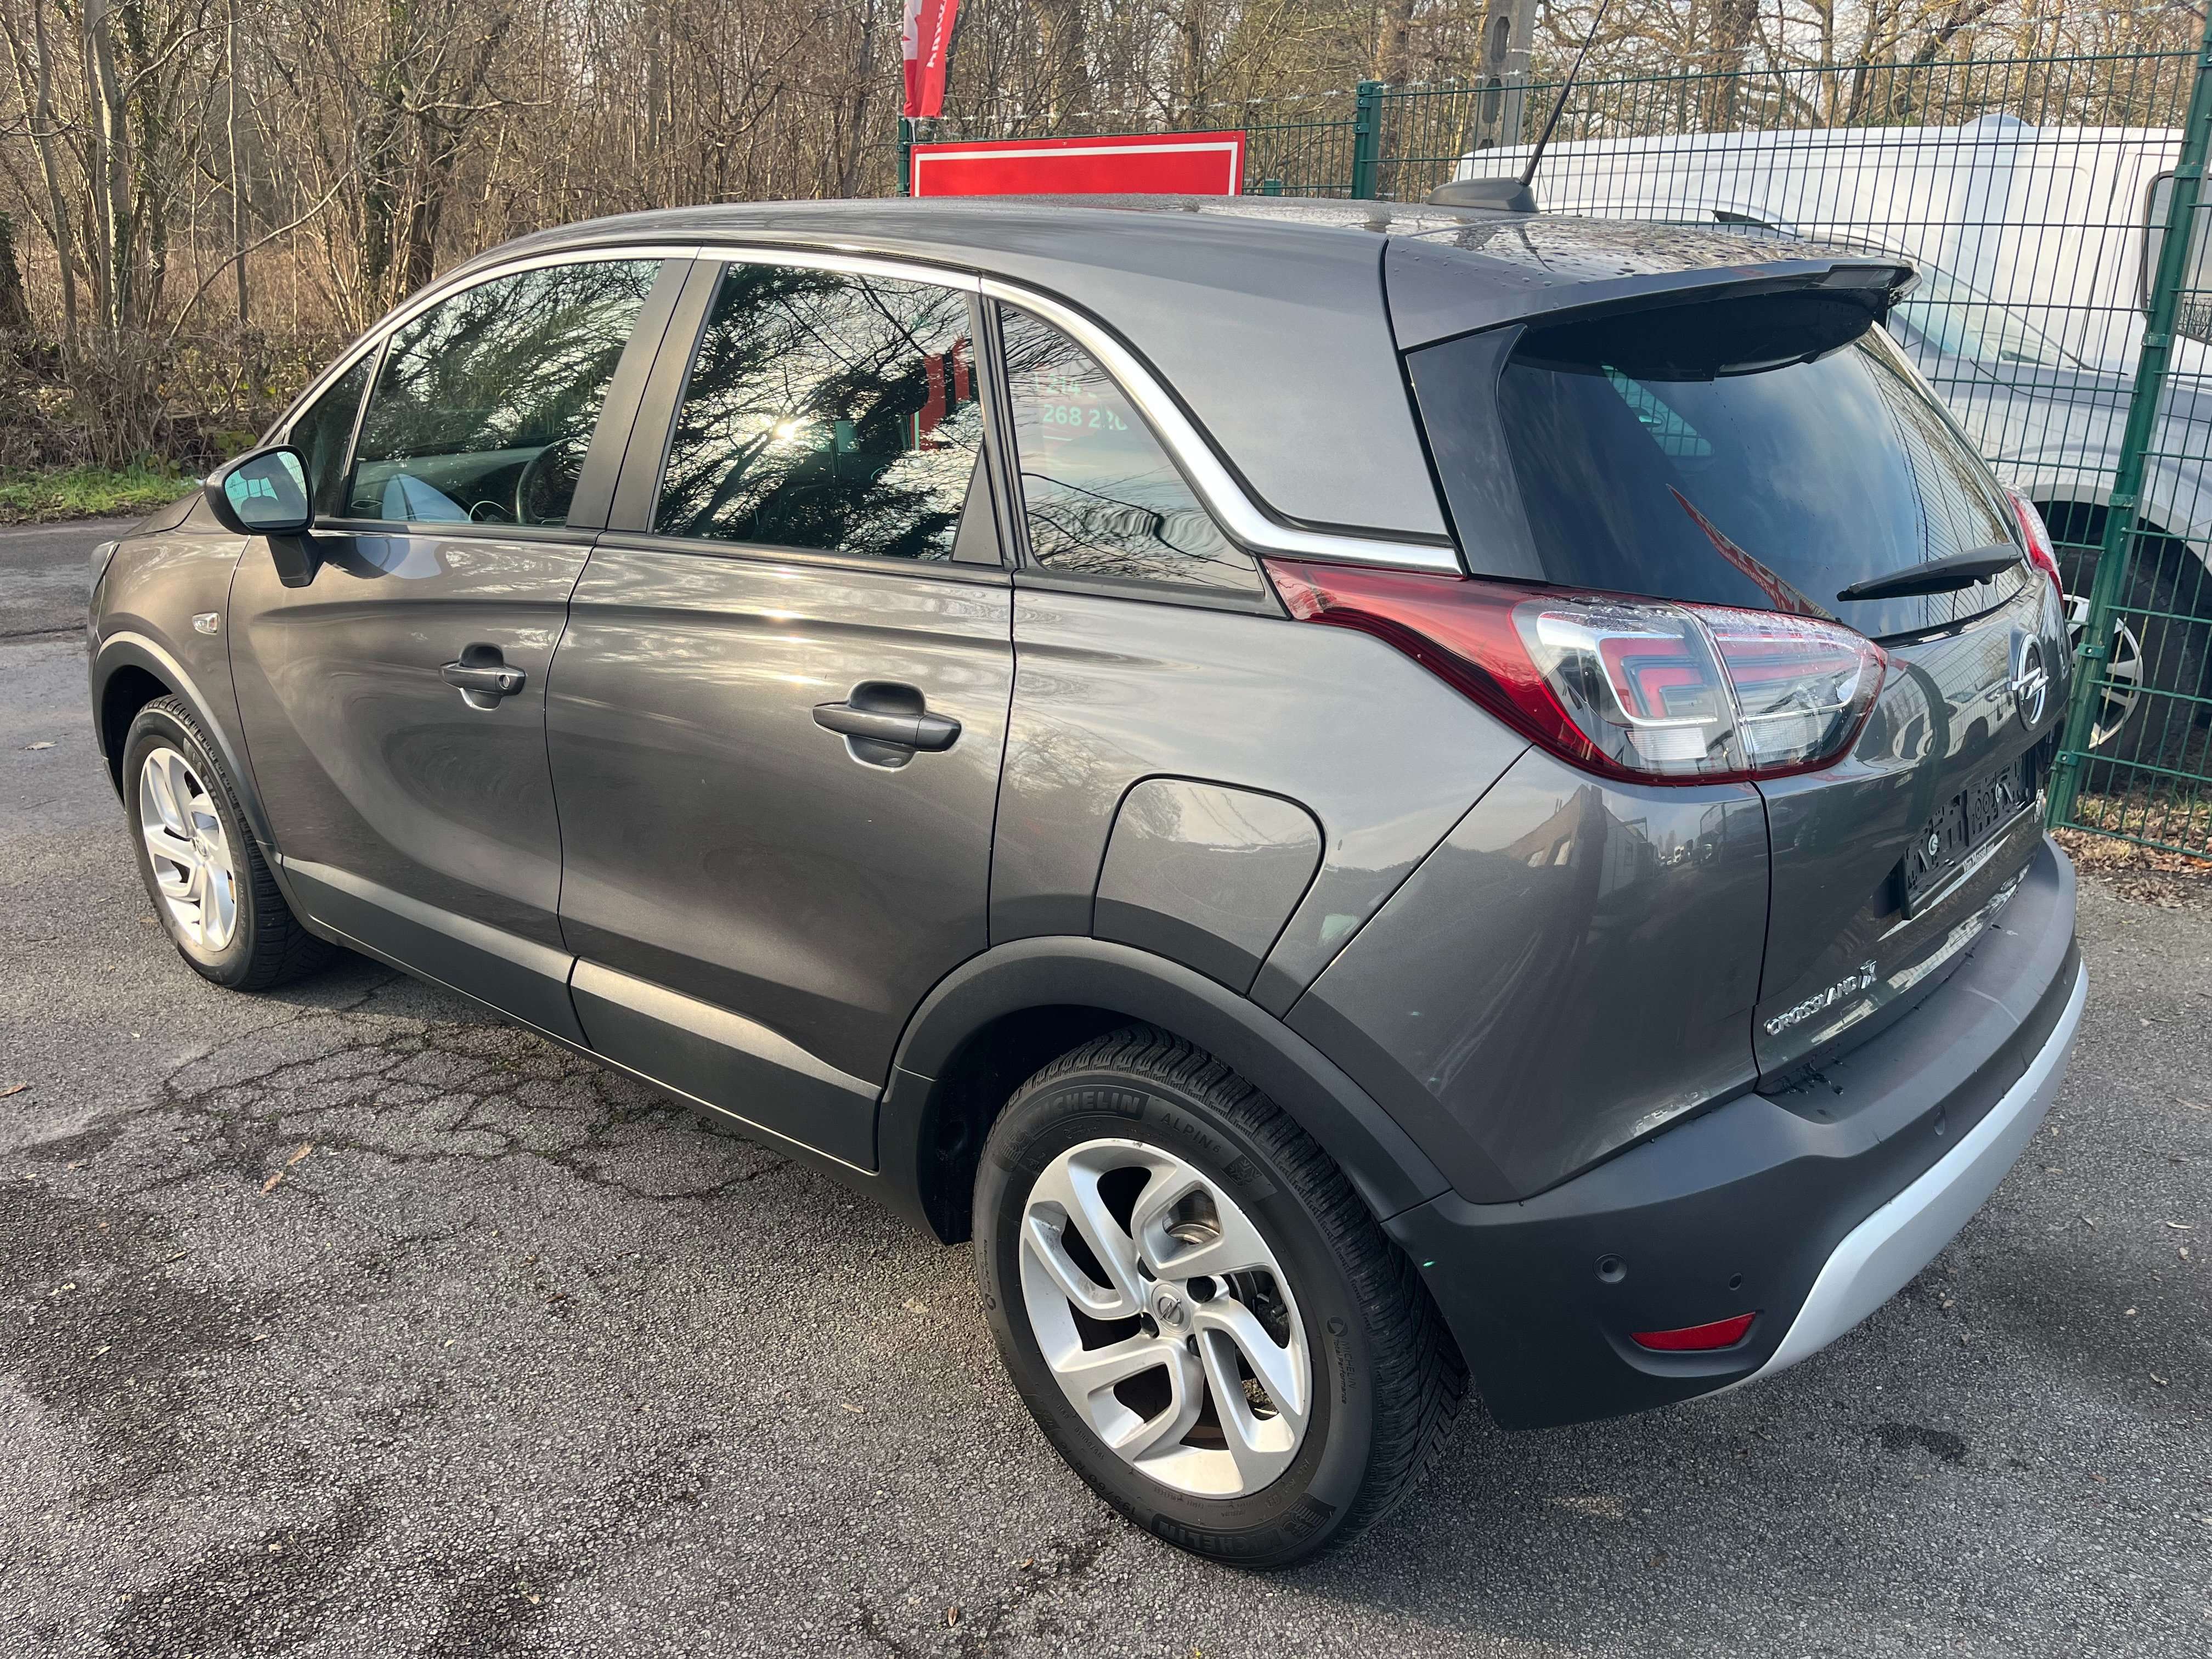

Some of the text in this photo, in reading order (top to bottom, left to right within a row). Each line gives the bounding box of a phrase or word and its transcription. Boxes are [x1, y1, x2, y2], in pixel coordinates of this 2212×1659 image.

[1043, 404, 1082, 426] 268
[1763, 960, 1877, 1035] CROSSLAND X
[1028, 1091, 1141, 1132] MICHELIN
[1160, 1113, 1215, 1152] ALPIN
[1341, 1340, 1357, 1389] MICHELIN
[1088, 1474, 1136, 1516] 195/60
[1158, 1521, 1284, 1553] MICHELIN
